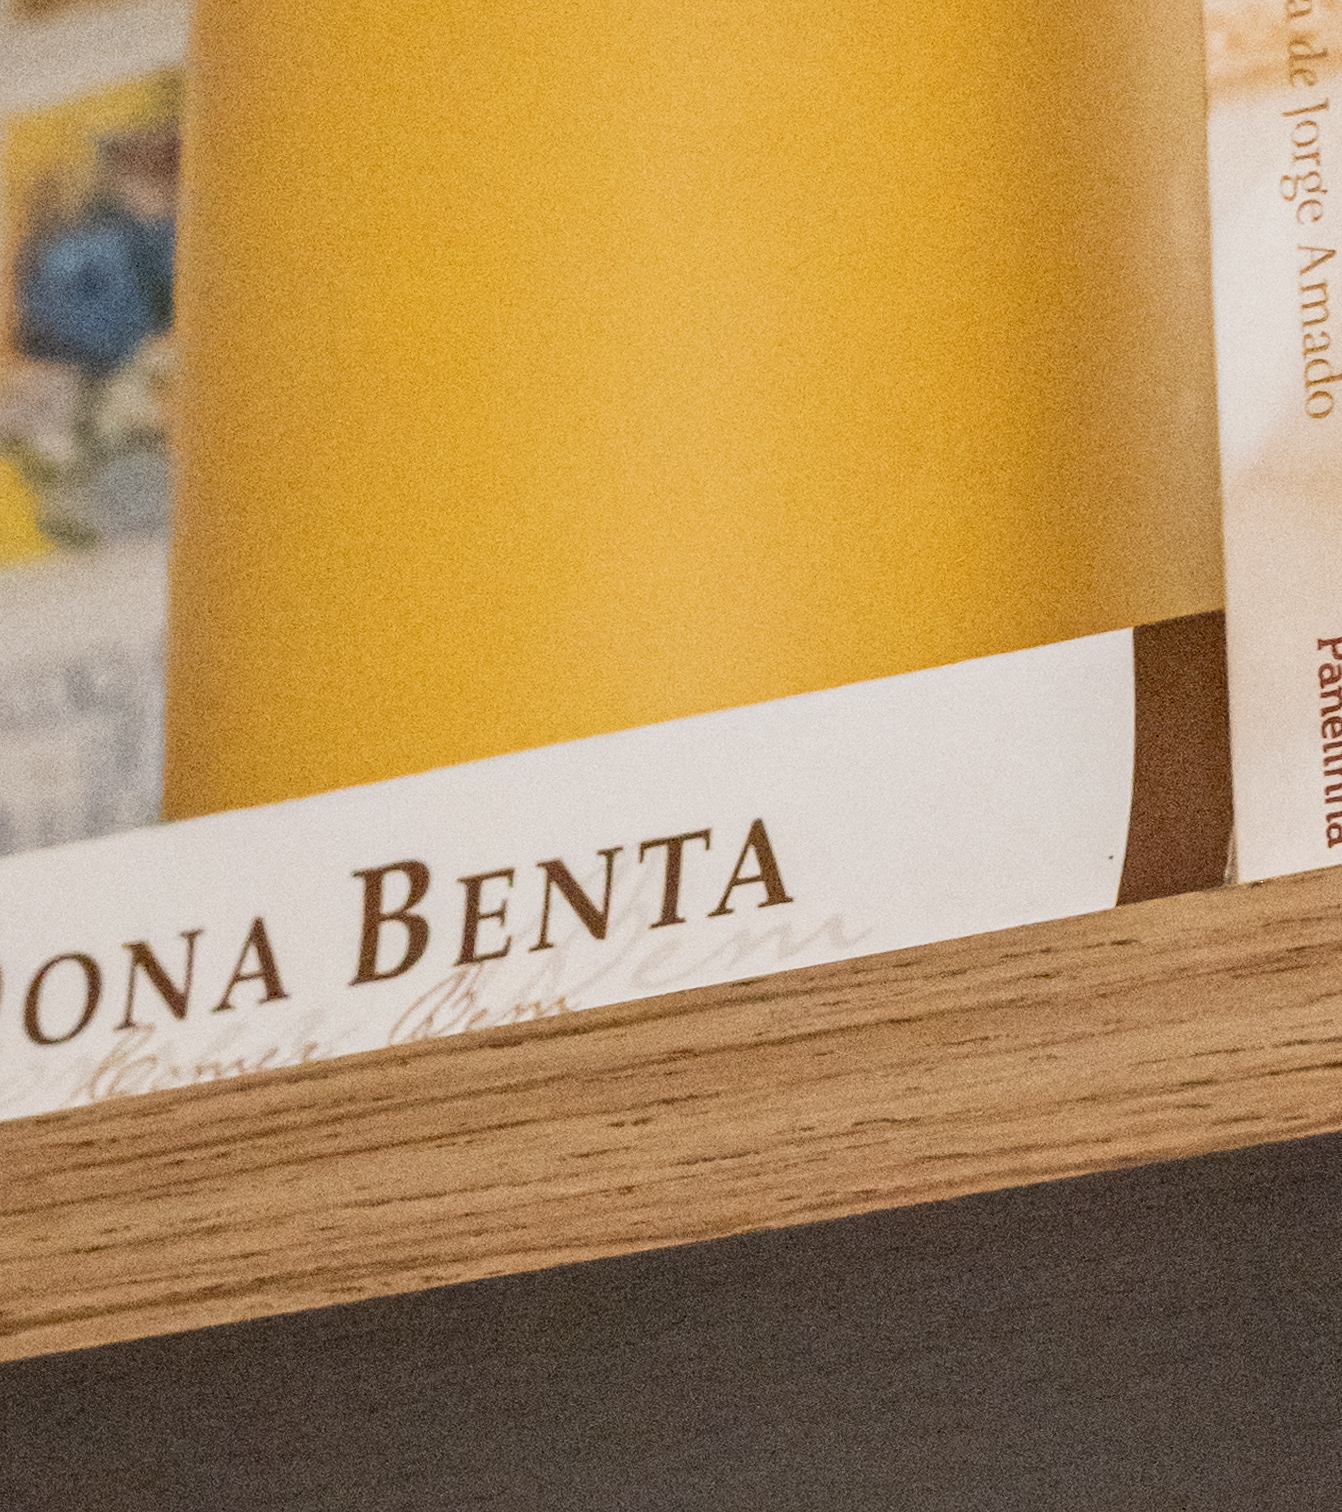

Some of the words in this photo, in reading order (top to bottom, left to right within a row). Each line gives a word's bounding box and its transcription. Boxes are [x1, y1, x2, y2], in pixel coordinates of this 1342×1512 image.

[1287, 32, 1329, 88] de
[1279, 96, 1331, 224] Jorge
[349, 818, 796, 988] BENTA
